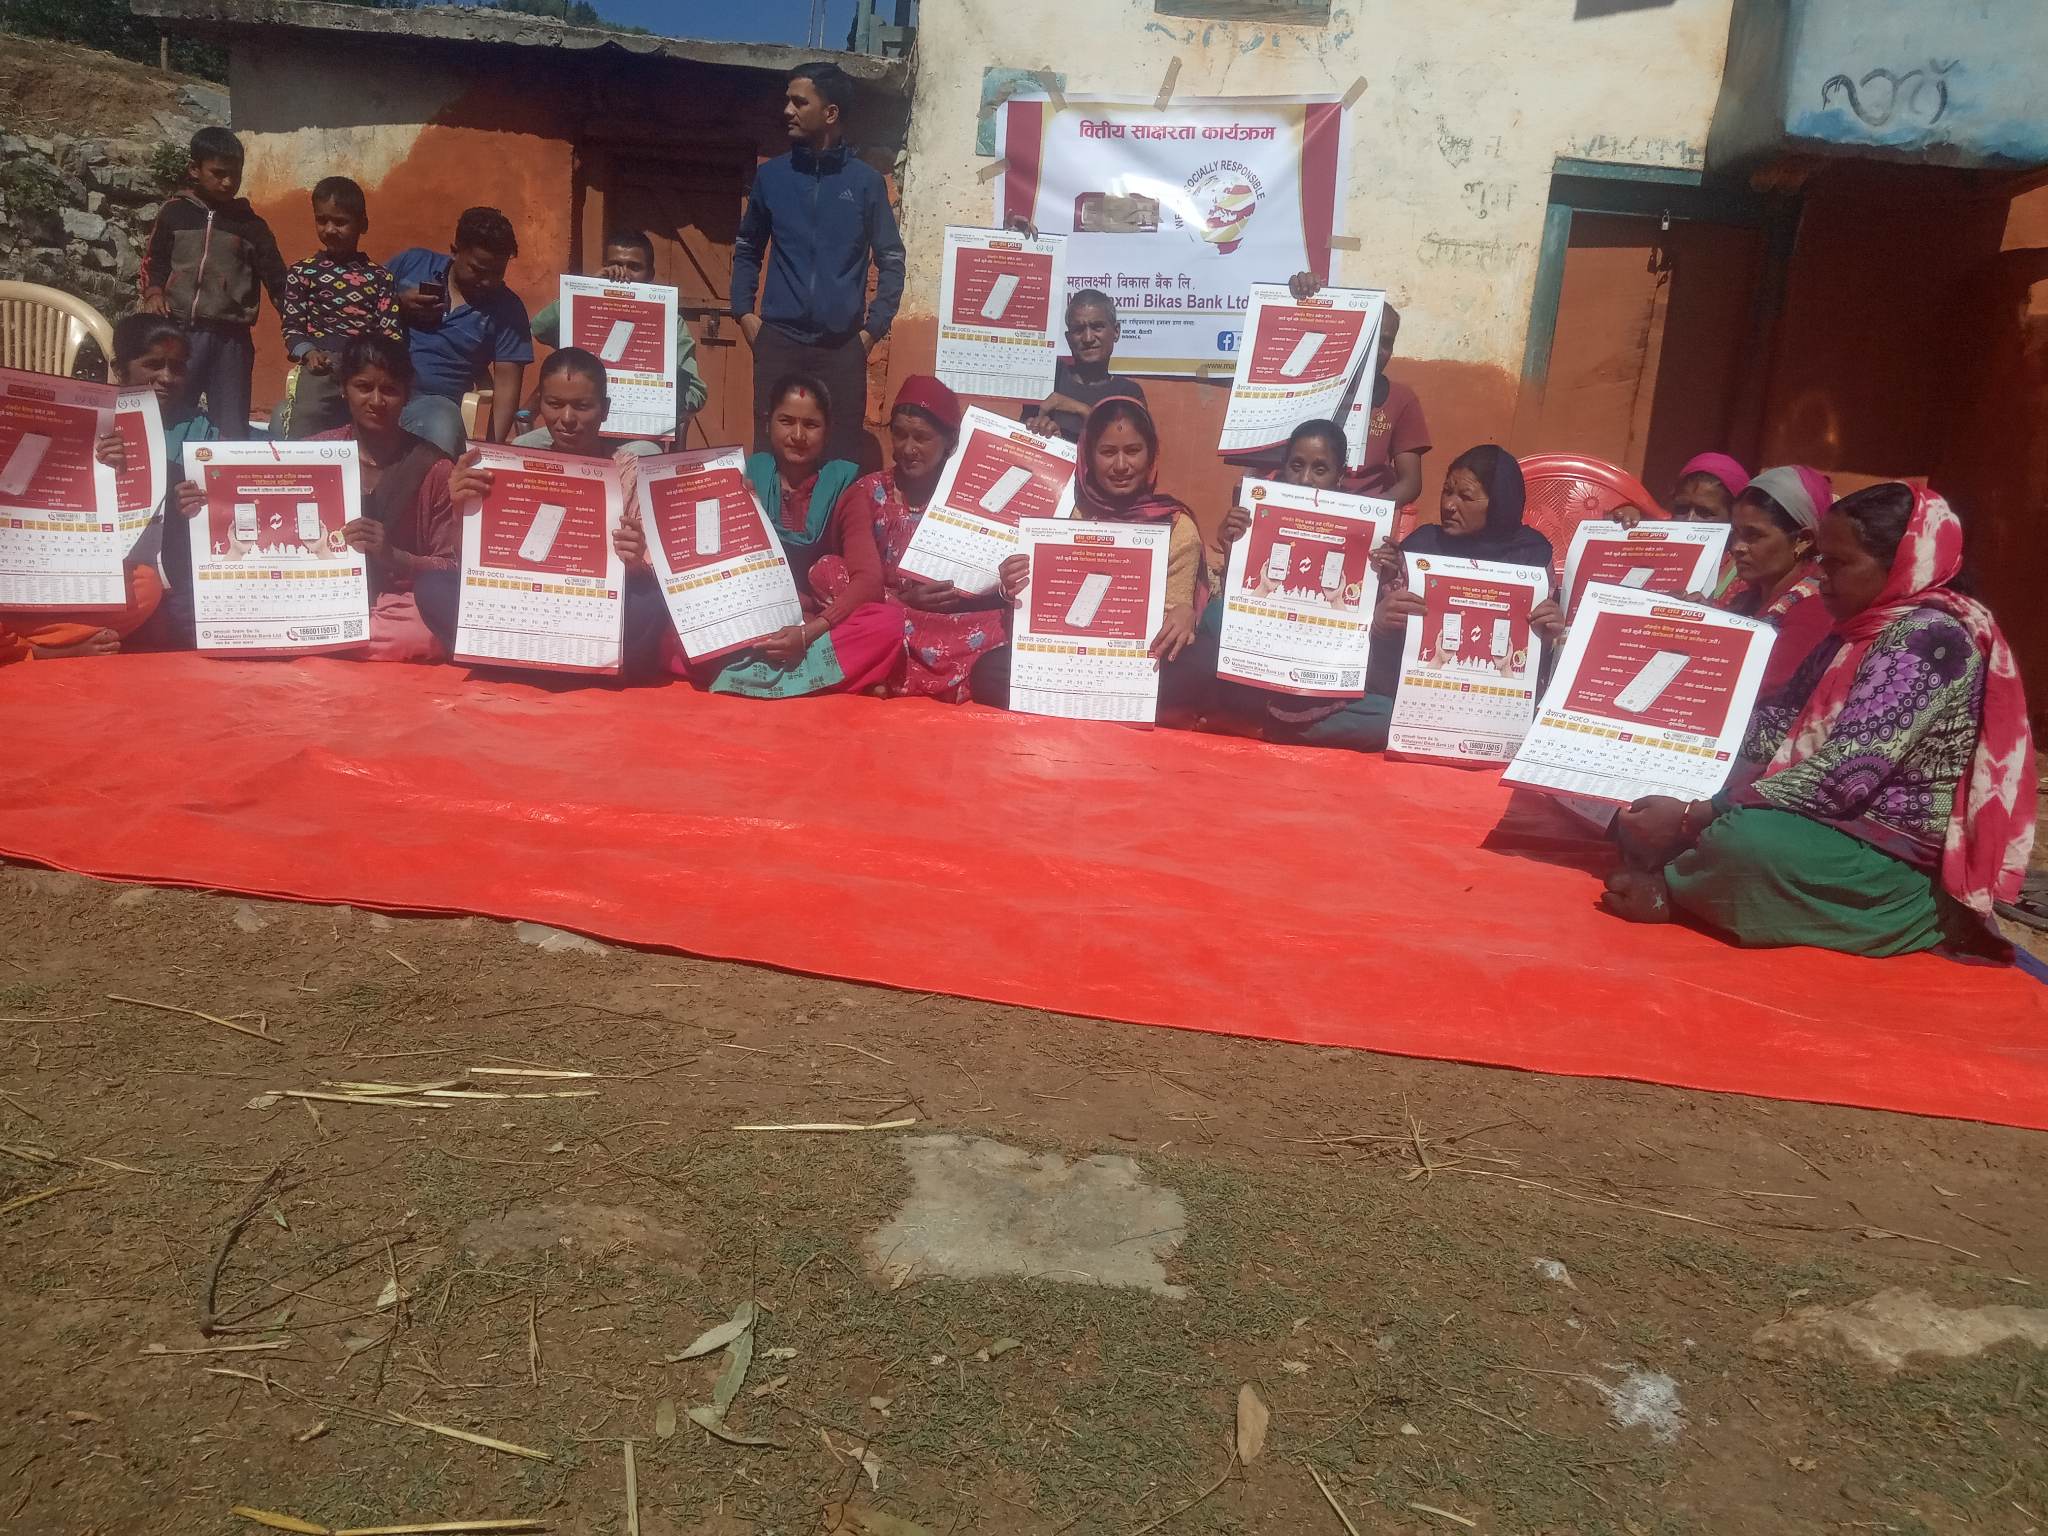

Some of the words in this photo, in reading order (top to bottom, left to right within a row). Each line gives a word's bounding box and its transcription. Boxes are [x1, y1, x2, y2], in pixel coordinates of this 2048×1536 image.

[1080, 120, 1125, 139] वित्तीय
[1131, 124, 1196, 141] साक्षरता
[1202, 124, 1277, 140] कार्यक्रम
[1220, 160, 1266, 201] RESPONSIBLE
[1066, 273, 1112, 290] महालक्ष्मी
[1117, 273, 1150, 289] विकास
[1144, 294, 1182, 309] Bikas
[1187, 294, 1222, 310] Bank
